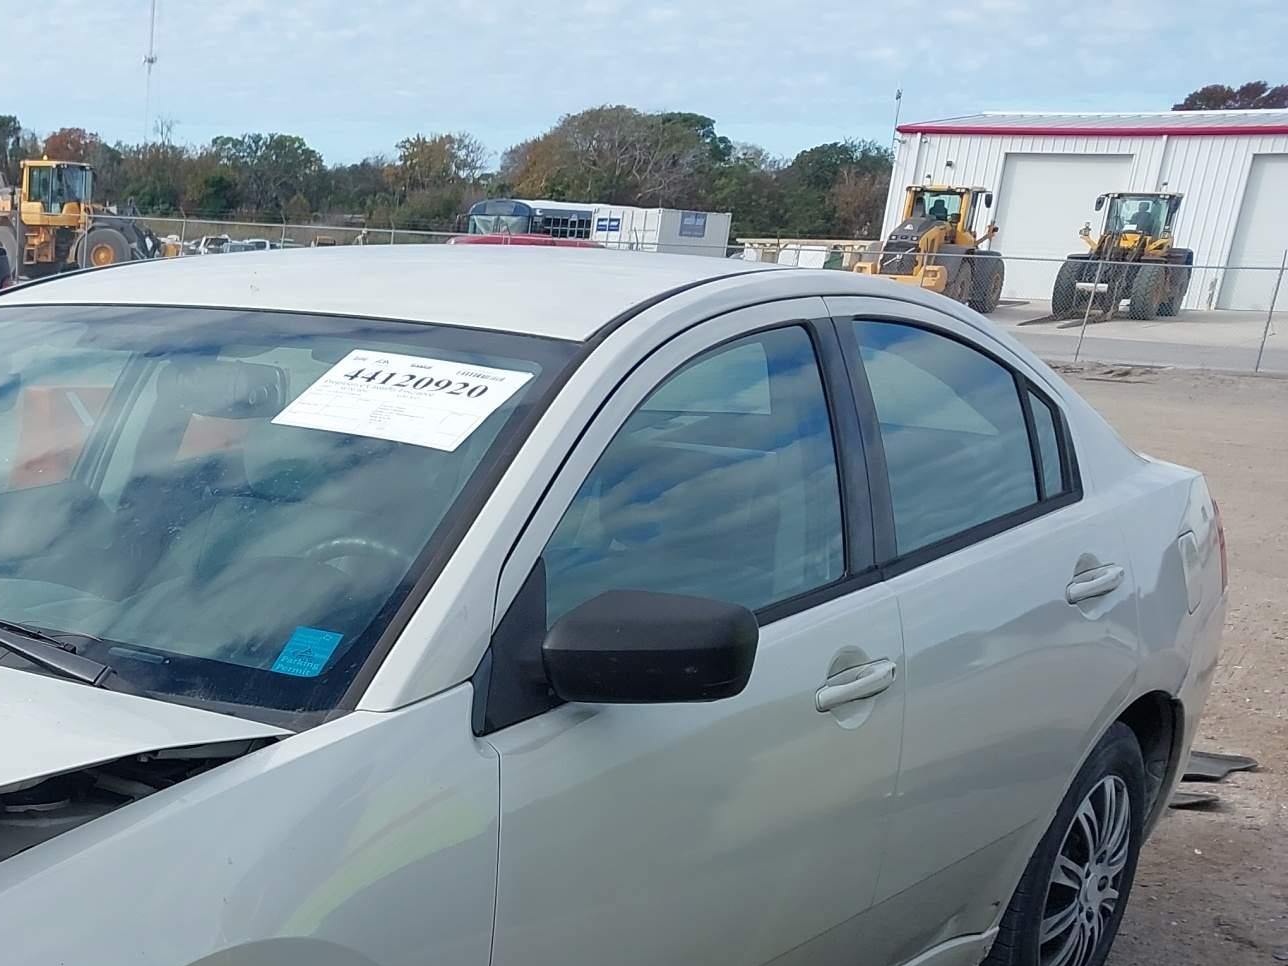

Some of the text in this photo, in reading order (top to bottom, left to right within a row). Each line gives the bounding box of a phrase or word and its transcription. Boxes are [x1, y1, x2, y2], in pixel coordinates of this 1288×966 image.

[343, 367, 490, 399] 44120920
[275, 663, 312, 676] Permit
[281, 655, 320, 670] Parking
